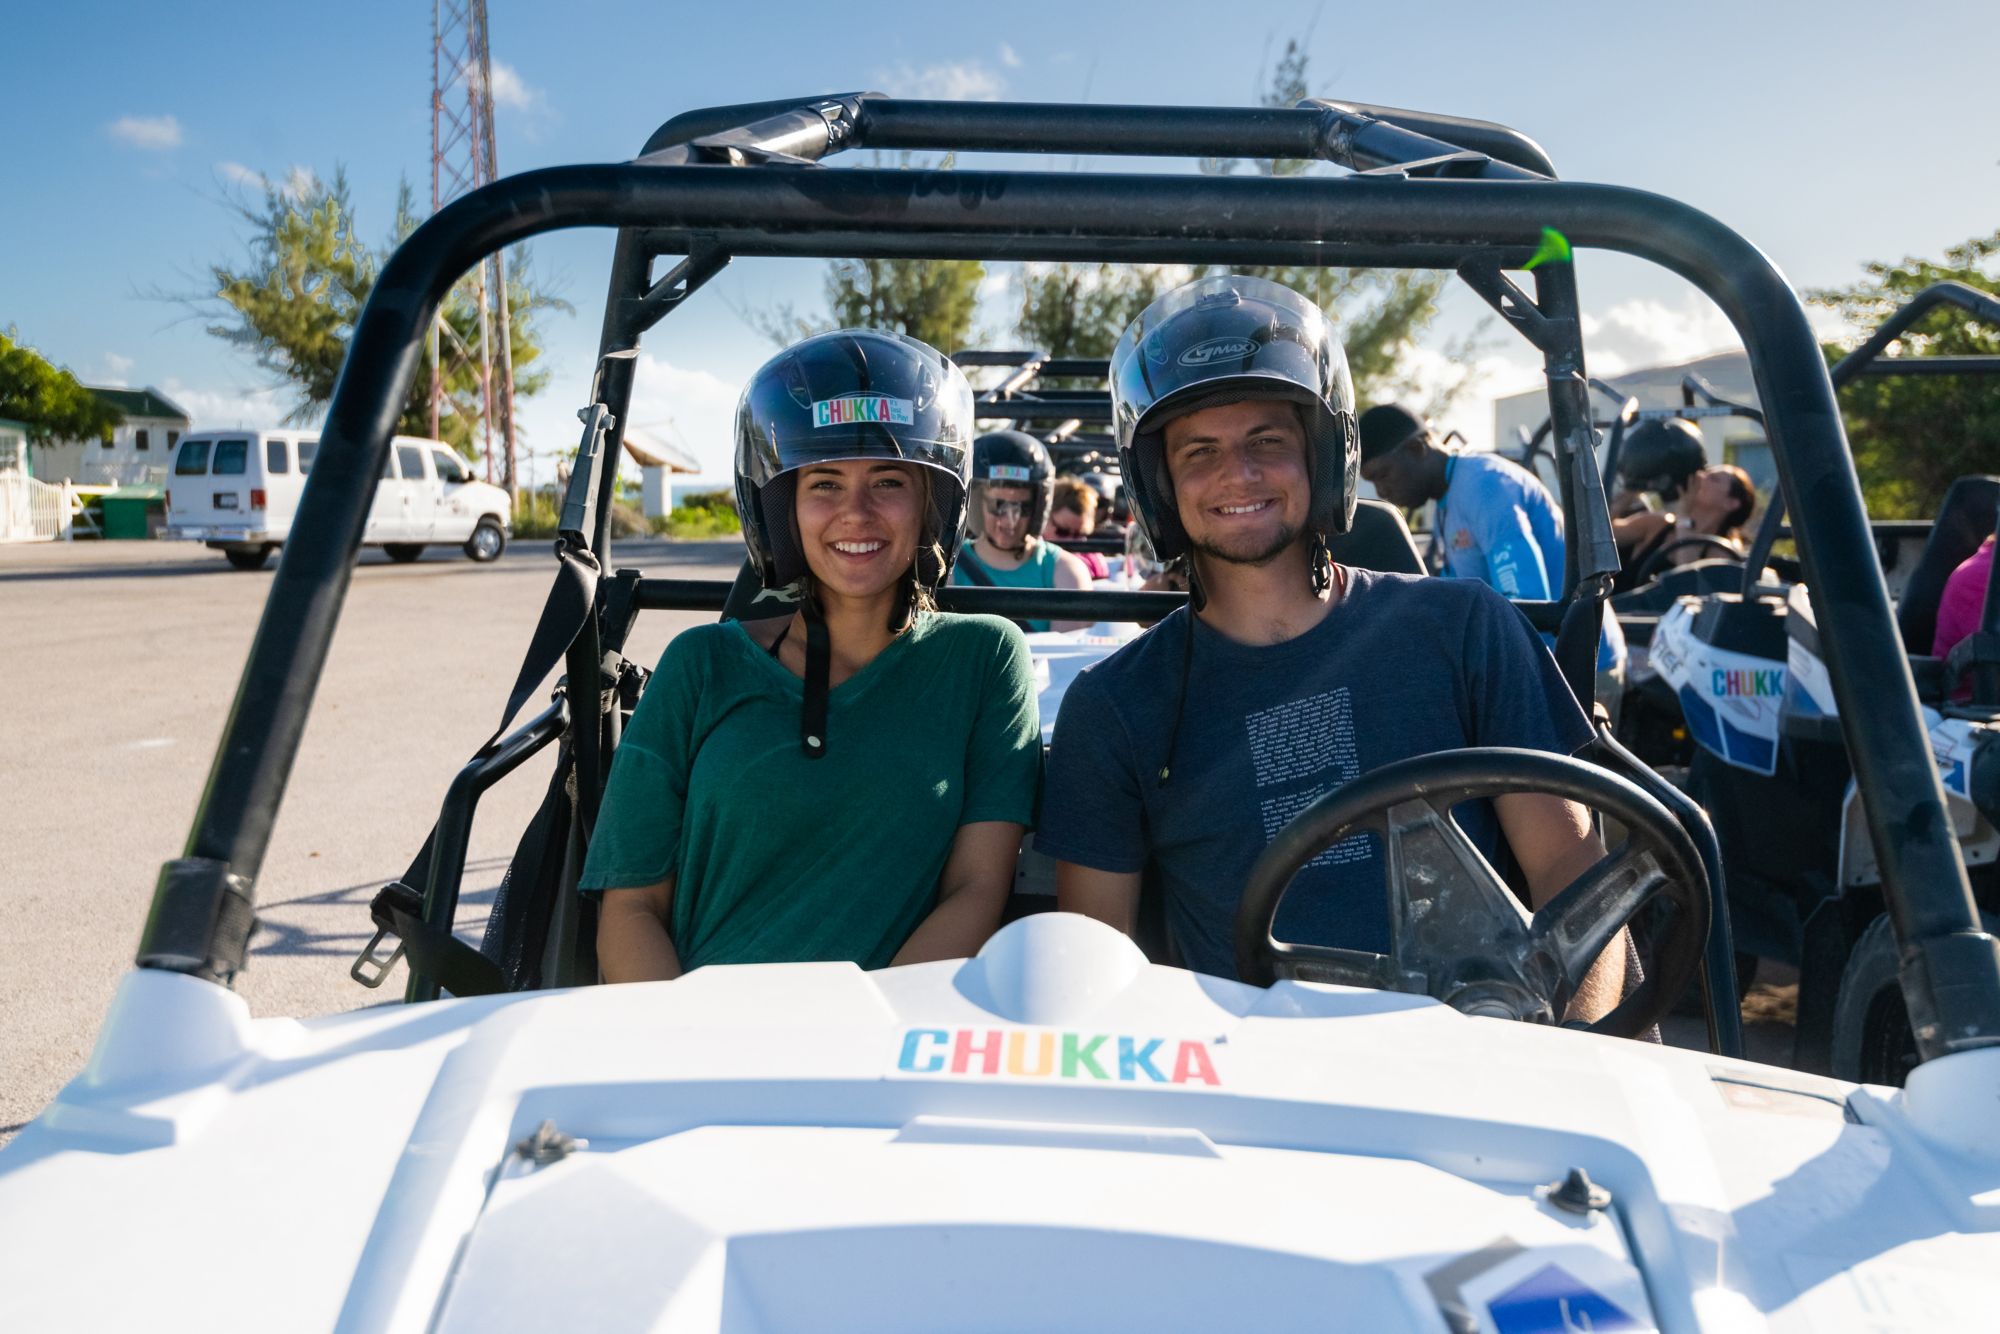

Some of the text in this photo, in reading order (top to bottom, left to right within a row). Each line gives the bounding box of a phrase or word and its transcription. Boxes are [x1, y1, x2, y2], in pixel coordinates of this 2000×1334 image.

[1181, 344, 1249, 363] GMAX
[817, 398, 891, 426] CHUKKA
[1711, 668, 1784, 698] CHUKK
[897, 1028, 1222, 1086] CHUKKA
